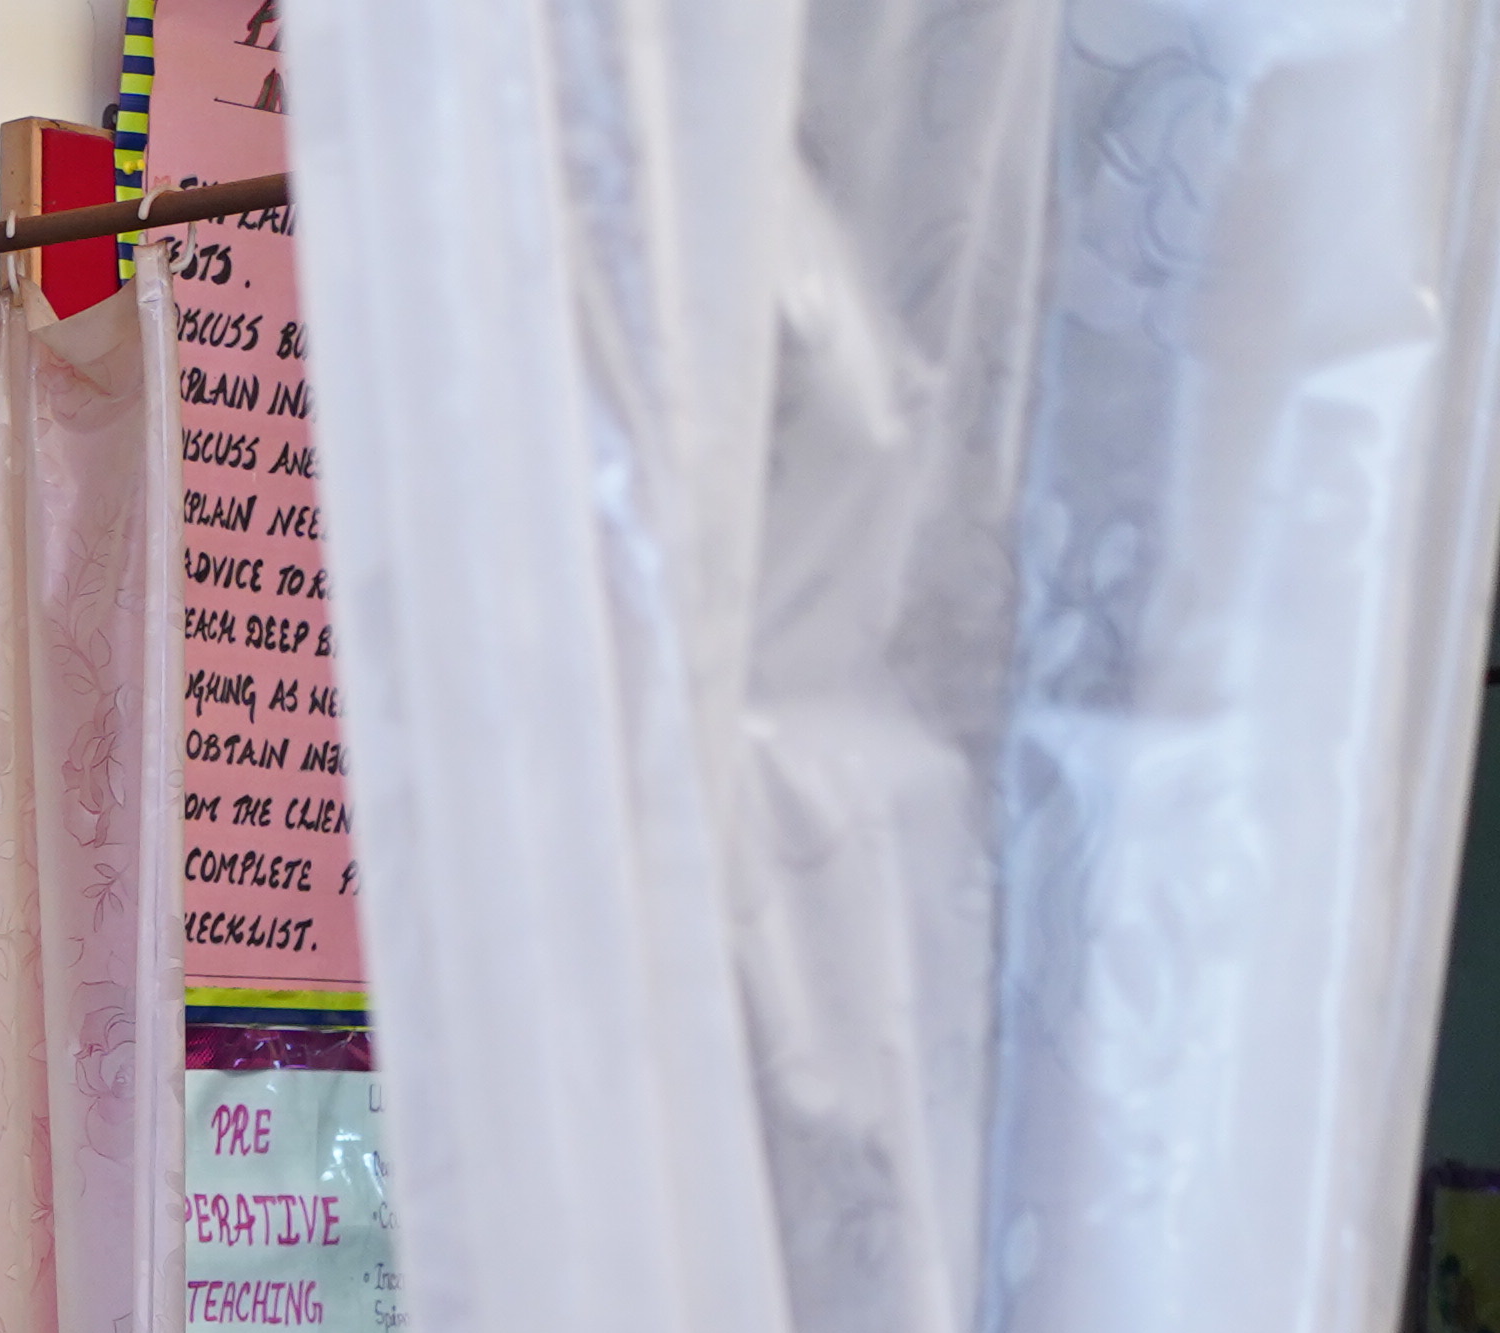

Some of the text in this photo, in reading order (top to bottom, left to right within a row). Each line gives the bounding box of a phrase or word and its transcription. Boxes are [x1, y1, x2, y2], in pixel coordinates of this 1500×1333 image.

[182, 426, 261, 471] ISCUSS
[276, 564, 305, 596] TO
[185, 606, 236, 644] EACH
[245, 614, 310, 654] DEEP
[268, 678, 299, 713] AS
[186, 728, 290, 770] OBTAIN
[232, 794, 274, 827] THE
[285, 797, 353, 835] CLIEN
[184, 846, 313, 892] COMPLETE
[211, 1103, 272, 1156] PRE
[187, 1279, 324, 1327] TEACHING
